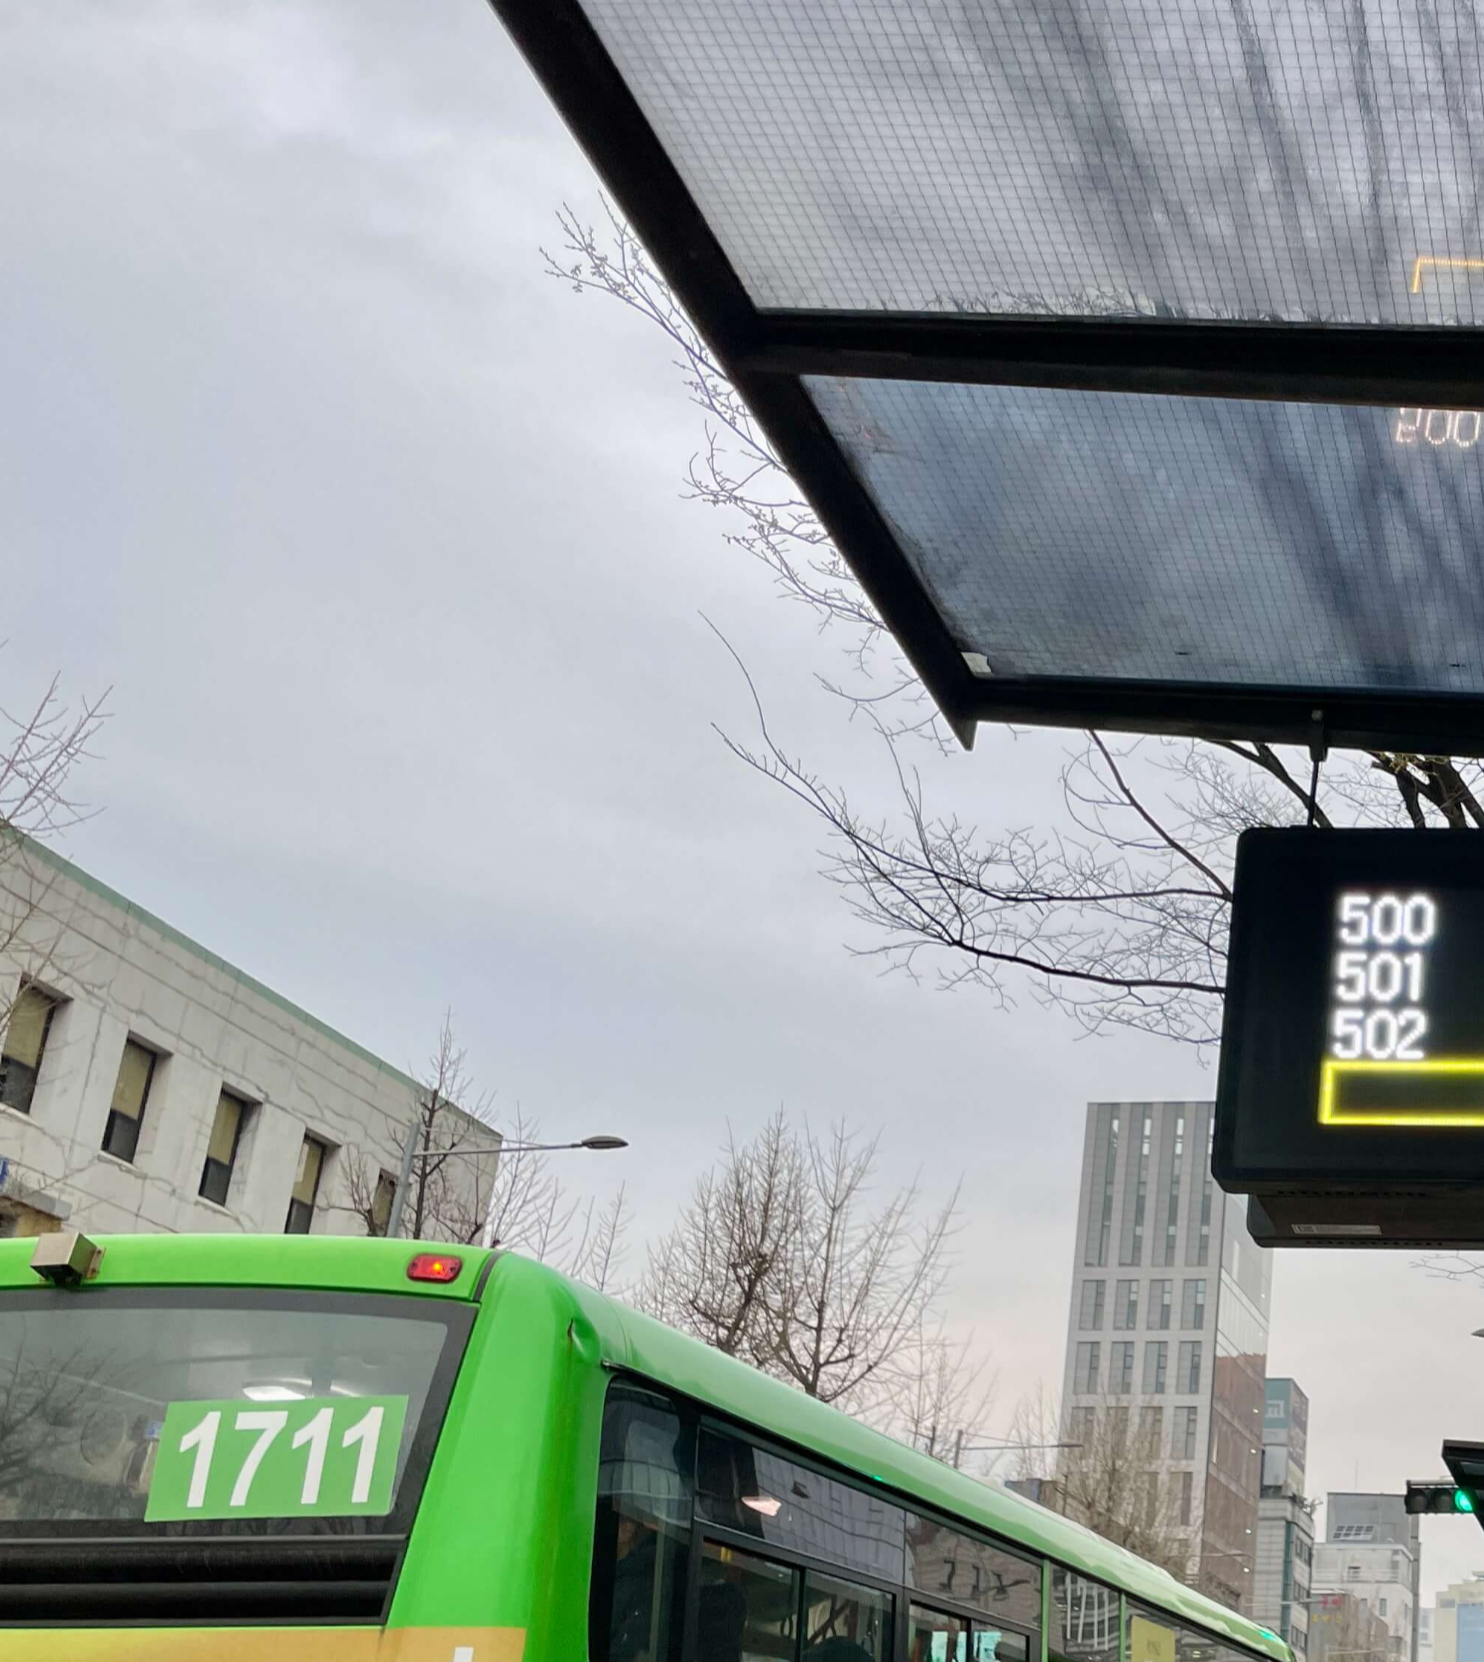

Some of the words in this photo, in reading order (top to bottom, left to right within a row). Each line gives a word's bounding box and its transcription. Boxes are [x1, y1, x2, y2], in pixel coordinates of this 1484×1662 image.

[1337, 892, 1437, 945] 500
[1335, 951, 1424, 1002] 501
[1332, 1009, 1428, 1061] 502
[178, 1405, 385, 1509] 1711
